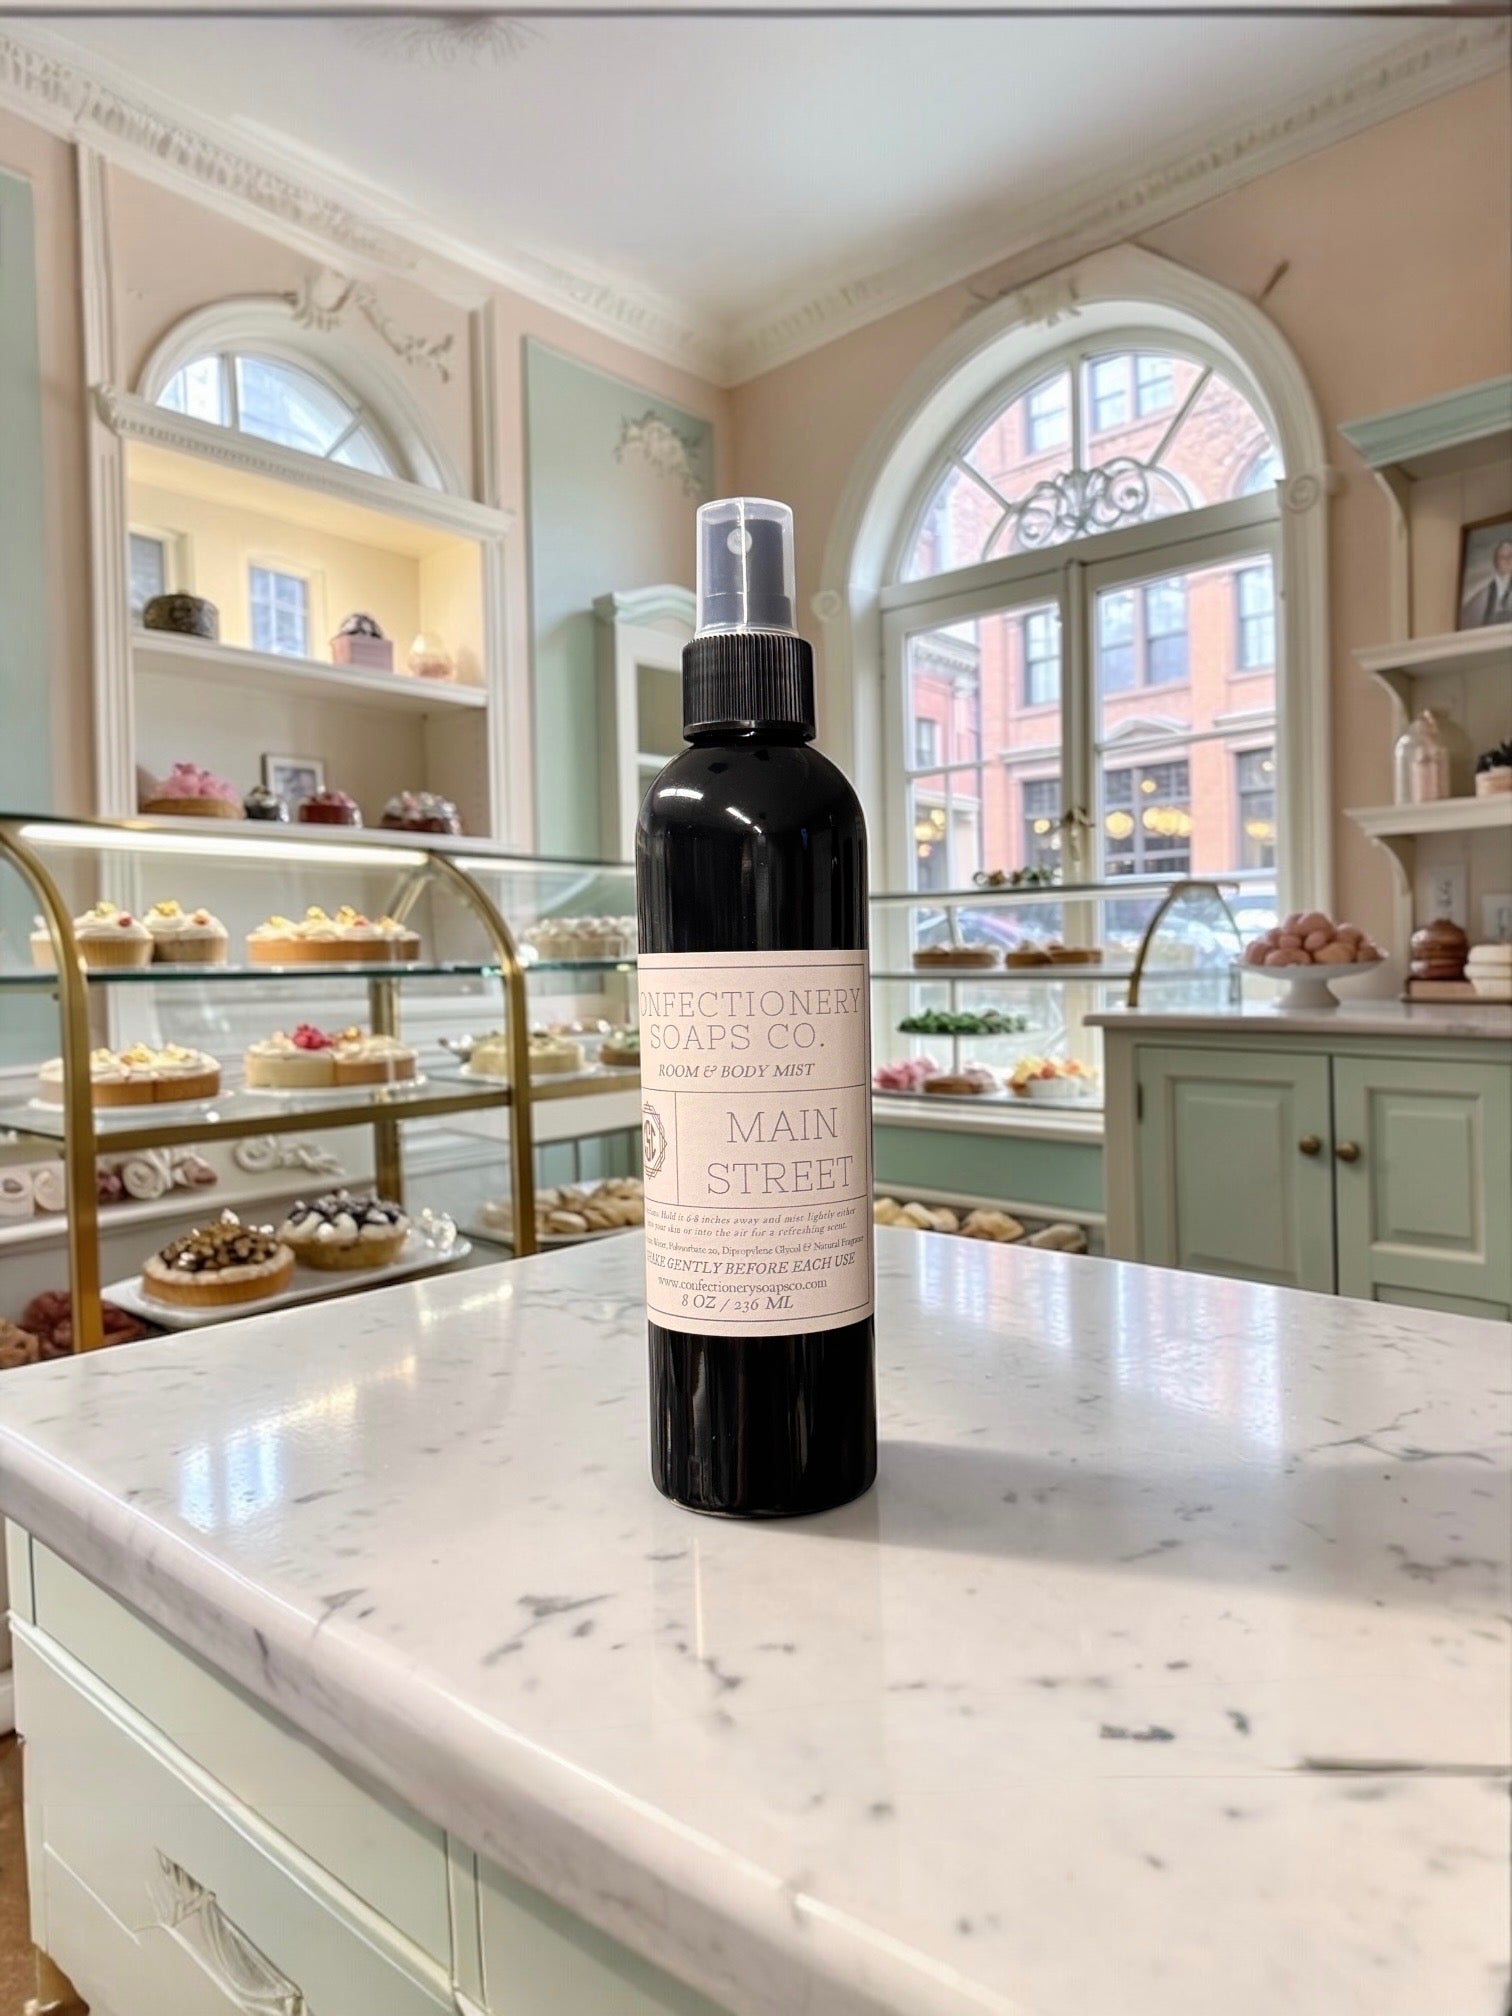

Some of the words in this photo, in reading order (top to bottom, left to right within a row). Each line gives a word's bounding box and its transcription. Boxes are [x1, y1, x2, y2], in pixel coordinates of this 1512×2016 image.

[650, 1024, 750, 1050] SOAPS
[767, 1022, 825, 1050] CO.
[658, 1063, 700, 1078] ROOM
[703, 1065, 717, 1078] &
[721, 1064, 769, 1078] BODY
[773, 1063, 815, 1077] MIST
[727, 1107, 838, 1143] MAIN
[707, 1155, 853, 1195] STREET
[661, 1210, 677, 1221] Hold
[686, 1214, 700, 1223] 6-8
[702, 1215, 730, 1224] inches
[733, 1217, 759, 1226] away
[763, 1214, 782, 1224] and
[784, 1214, 804, 1223] mist
[807, 1210, 835, 1223] lightly
[837, 1207, 856, 1218] either
[694, 1228, 713, 1237] into
[715, 1228, 731, 1237] the
[751, 1227, 767, 1237] for
[778, 1225, 825, 1237] refreshing
[827, 1222, 848, 1232] scent.
[708, 1248, 720, 1256] 20,
[722, 1246, 773, 1257] Dipropylene
[775, 1243, 801, 1256] Glycol
[803, 1243, 812, 1252] &
[814, 1239, 840, 1251] Natural
[667, 1258, 722, 1275] GENTLY
[725, 1261, 789, 1275] BEFORE
[792, 1256, 832, 1273] EACH
[834, 1251, 856, 1267] USE
[658, 1275, 828, 1297] www.confectionerysoapsco.com
[681, 1294, 689, 1307] 8
[693, 1295, 717, 1309] OZ
[719, 1298, 731, 1313] /
[734, 1299, 759, 1313] 236
[765, 1296, 794, 1309] ML
